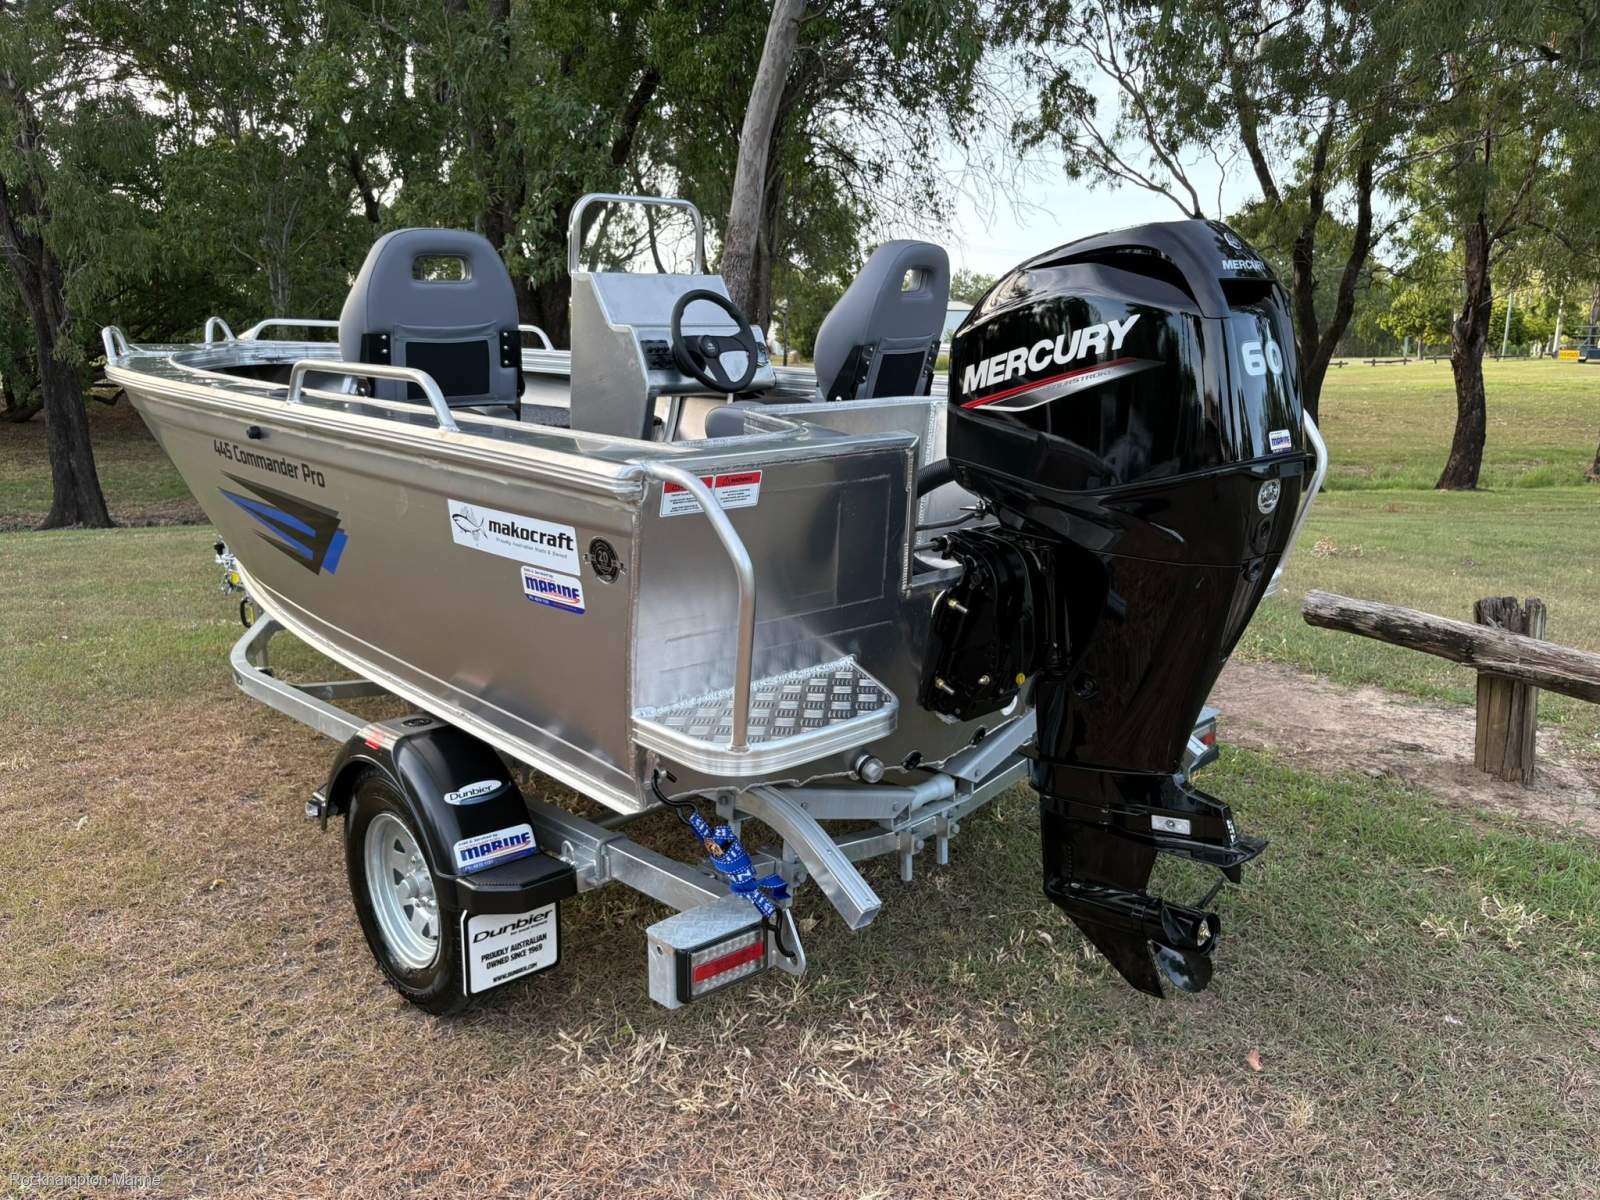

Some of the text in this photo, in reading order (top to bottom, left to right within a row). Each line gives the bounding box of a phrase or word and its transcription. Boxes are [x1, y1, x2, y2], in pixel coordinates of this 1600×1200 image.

[1222, 259, 1266, 272] MERCURY
[963, 314, 1141, 394] MERCURY
[1242, 341, 1283, 376] 60
[213, 439, 326, 488] 445 Commander Pro
[488, 519, 574, 551] makocraft
[524, 575, 580, 600] MARINE
[449, 783, 493, 801] Dunbier
[460, 831, 531, 862] MARINE
[473, 909, 553, 944] Dunbier
[481, 932, 547, 963] PROUDLY AUSTRALIAN
[486, 943, 543, 970] OWNED SINCE 1969
